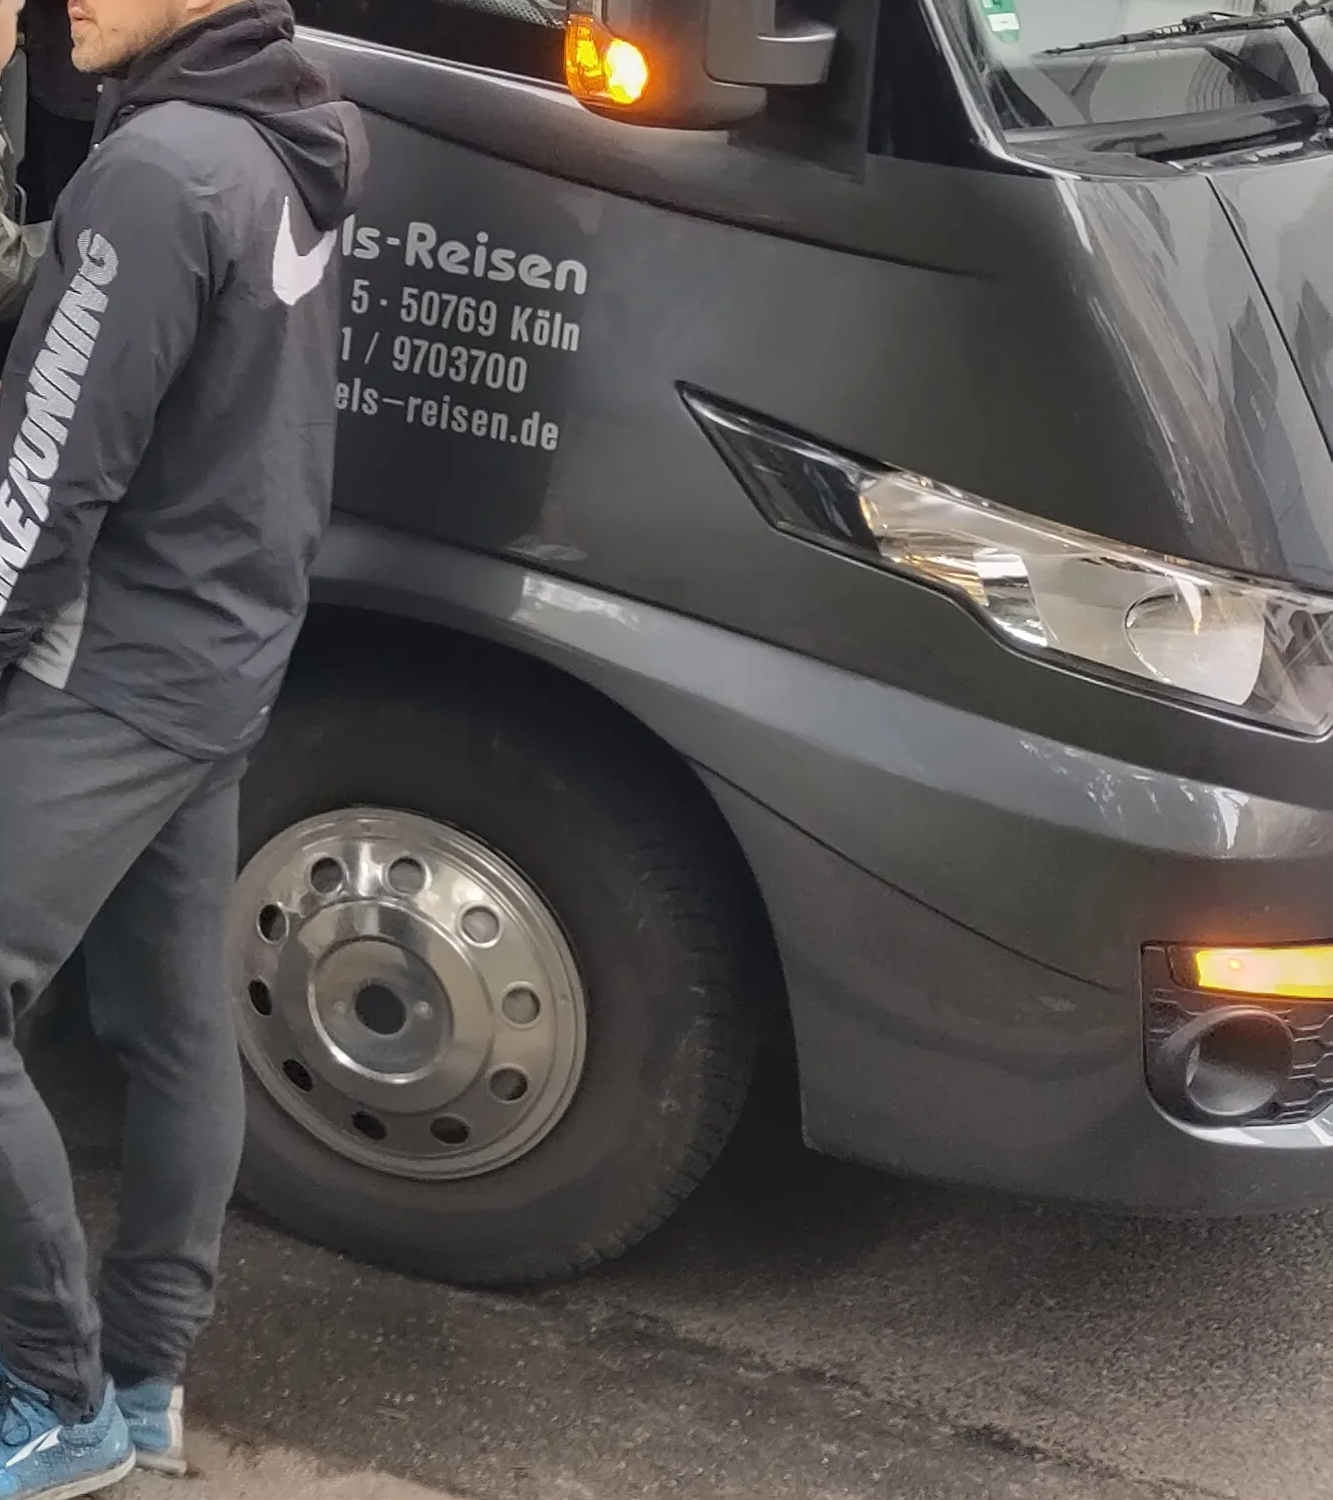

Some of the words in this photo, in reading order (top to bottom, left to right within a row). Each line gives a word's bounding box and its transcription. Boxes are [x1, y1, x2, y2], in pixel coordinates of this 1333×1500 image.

[342, 213, 588, 295] ls-Reisen
[400, 286, 497, 337] 50769
[510, 305, 580, 352] Köln
[391, 336, 528, 394] 9703700
